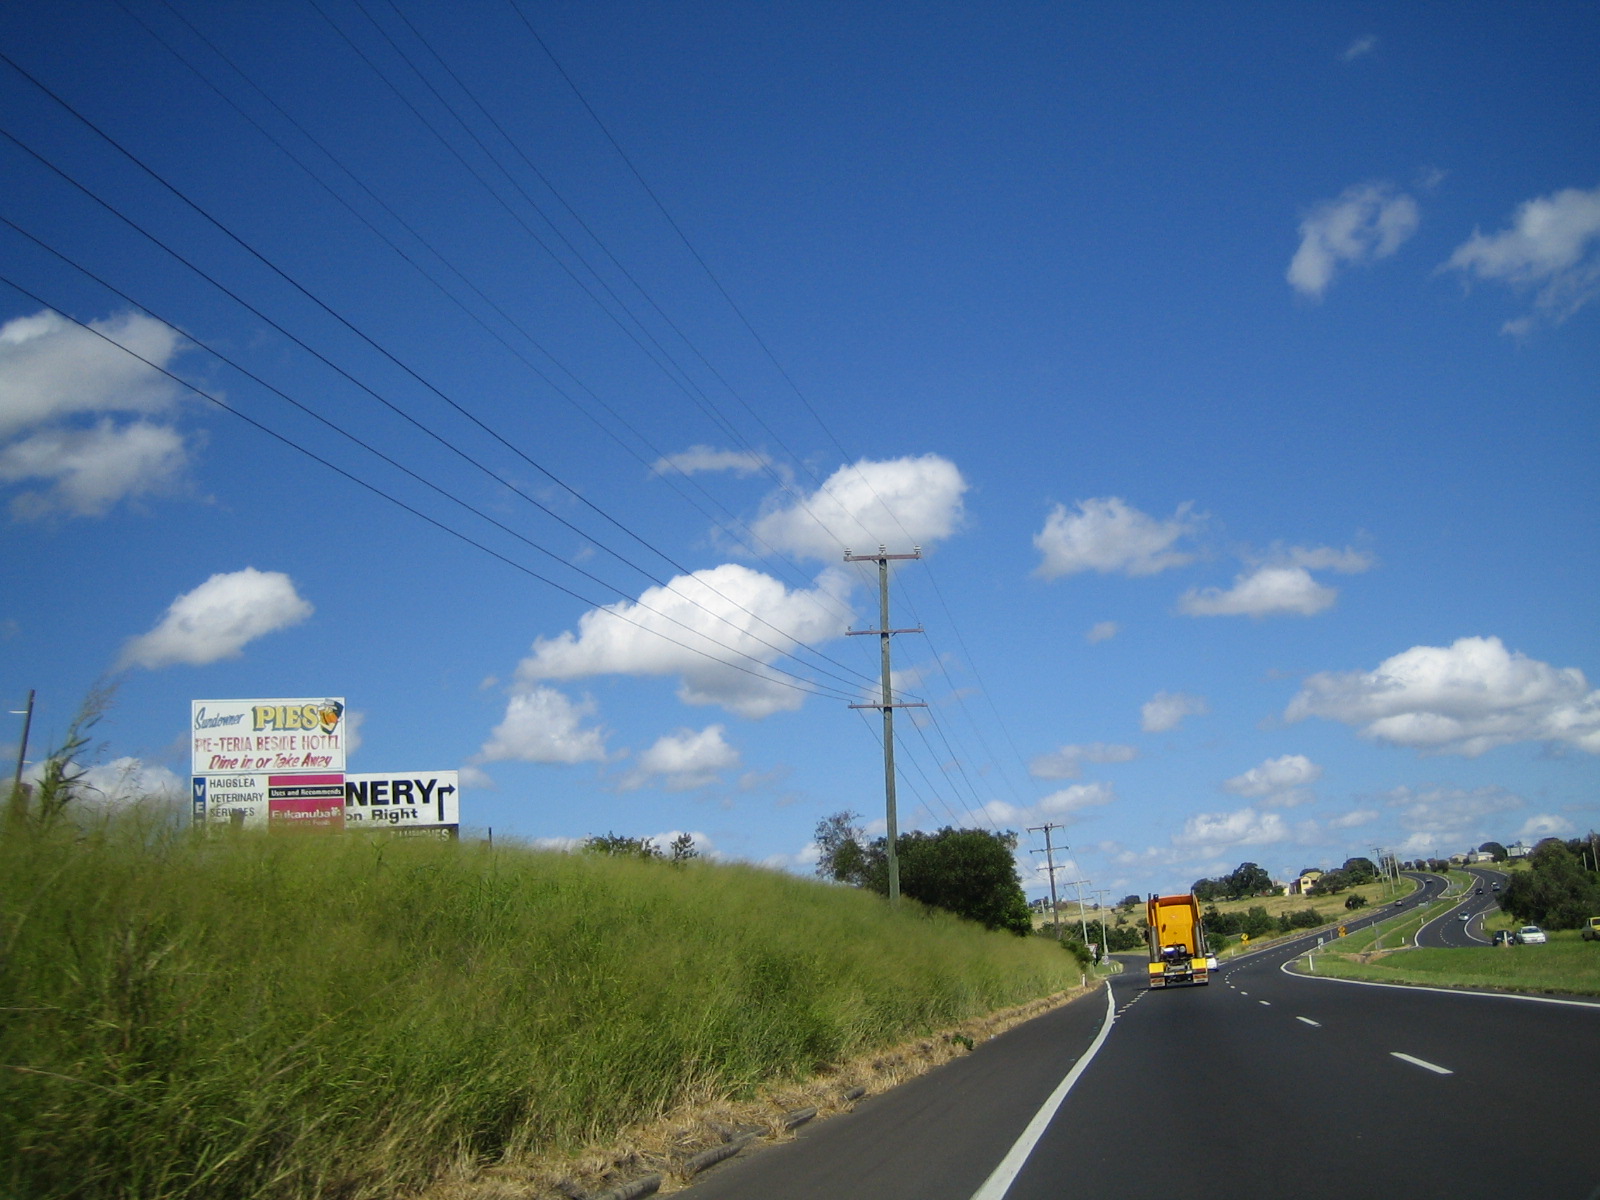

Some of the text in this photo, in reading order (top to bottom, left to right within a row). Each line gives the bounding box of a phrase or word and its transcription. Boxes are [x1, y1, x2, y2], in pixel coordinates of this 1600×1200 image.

[195, 707, 245, 730] Sundowner
[252, 704, 319, 731] PIES
[195, 736, 252, 752] PIE-TERIA
[257, 736, 296, 751] BESIDE
[209, 752, 332, 769] Dine in or Take Away
[210, 779, 255, 788] HAIGSLEA
[210, 793, 264, 802] VETERINARY
[301, 788, 341, 796] Recommends
[345, 779, 438, 806] NERY
[210, 807, 255, 817] SERVES
[346, 808, 418, 824] on Right
